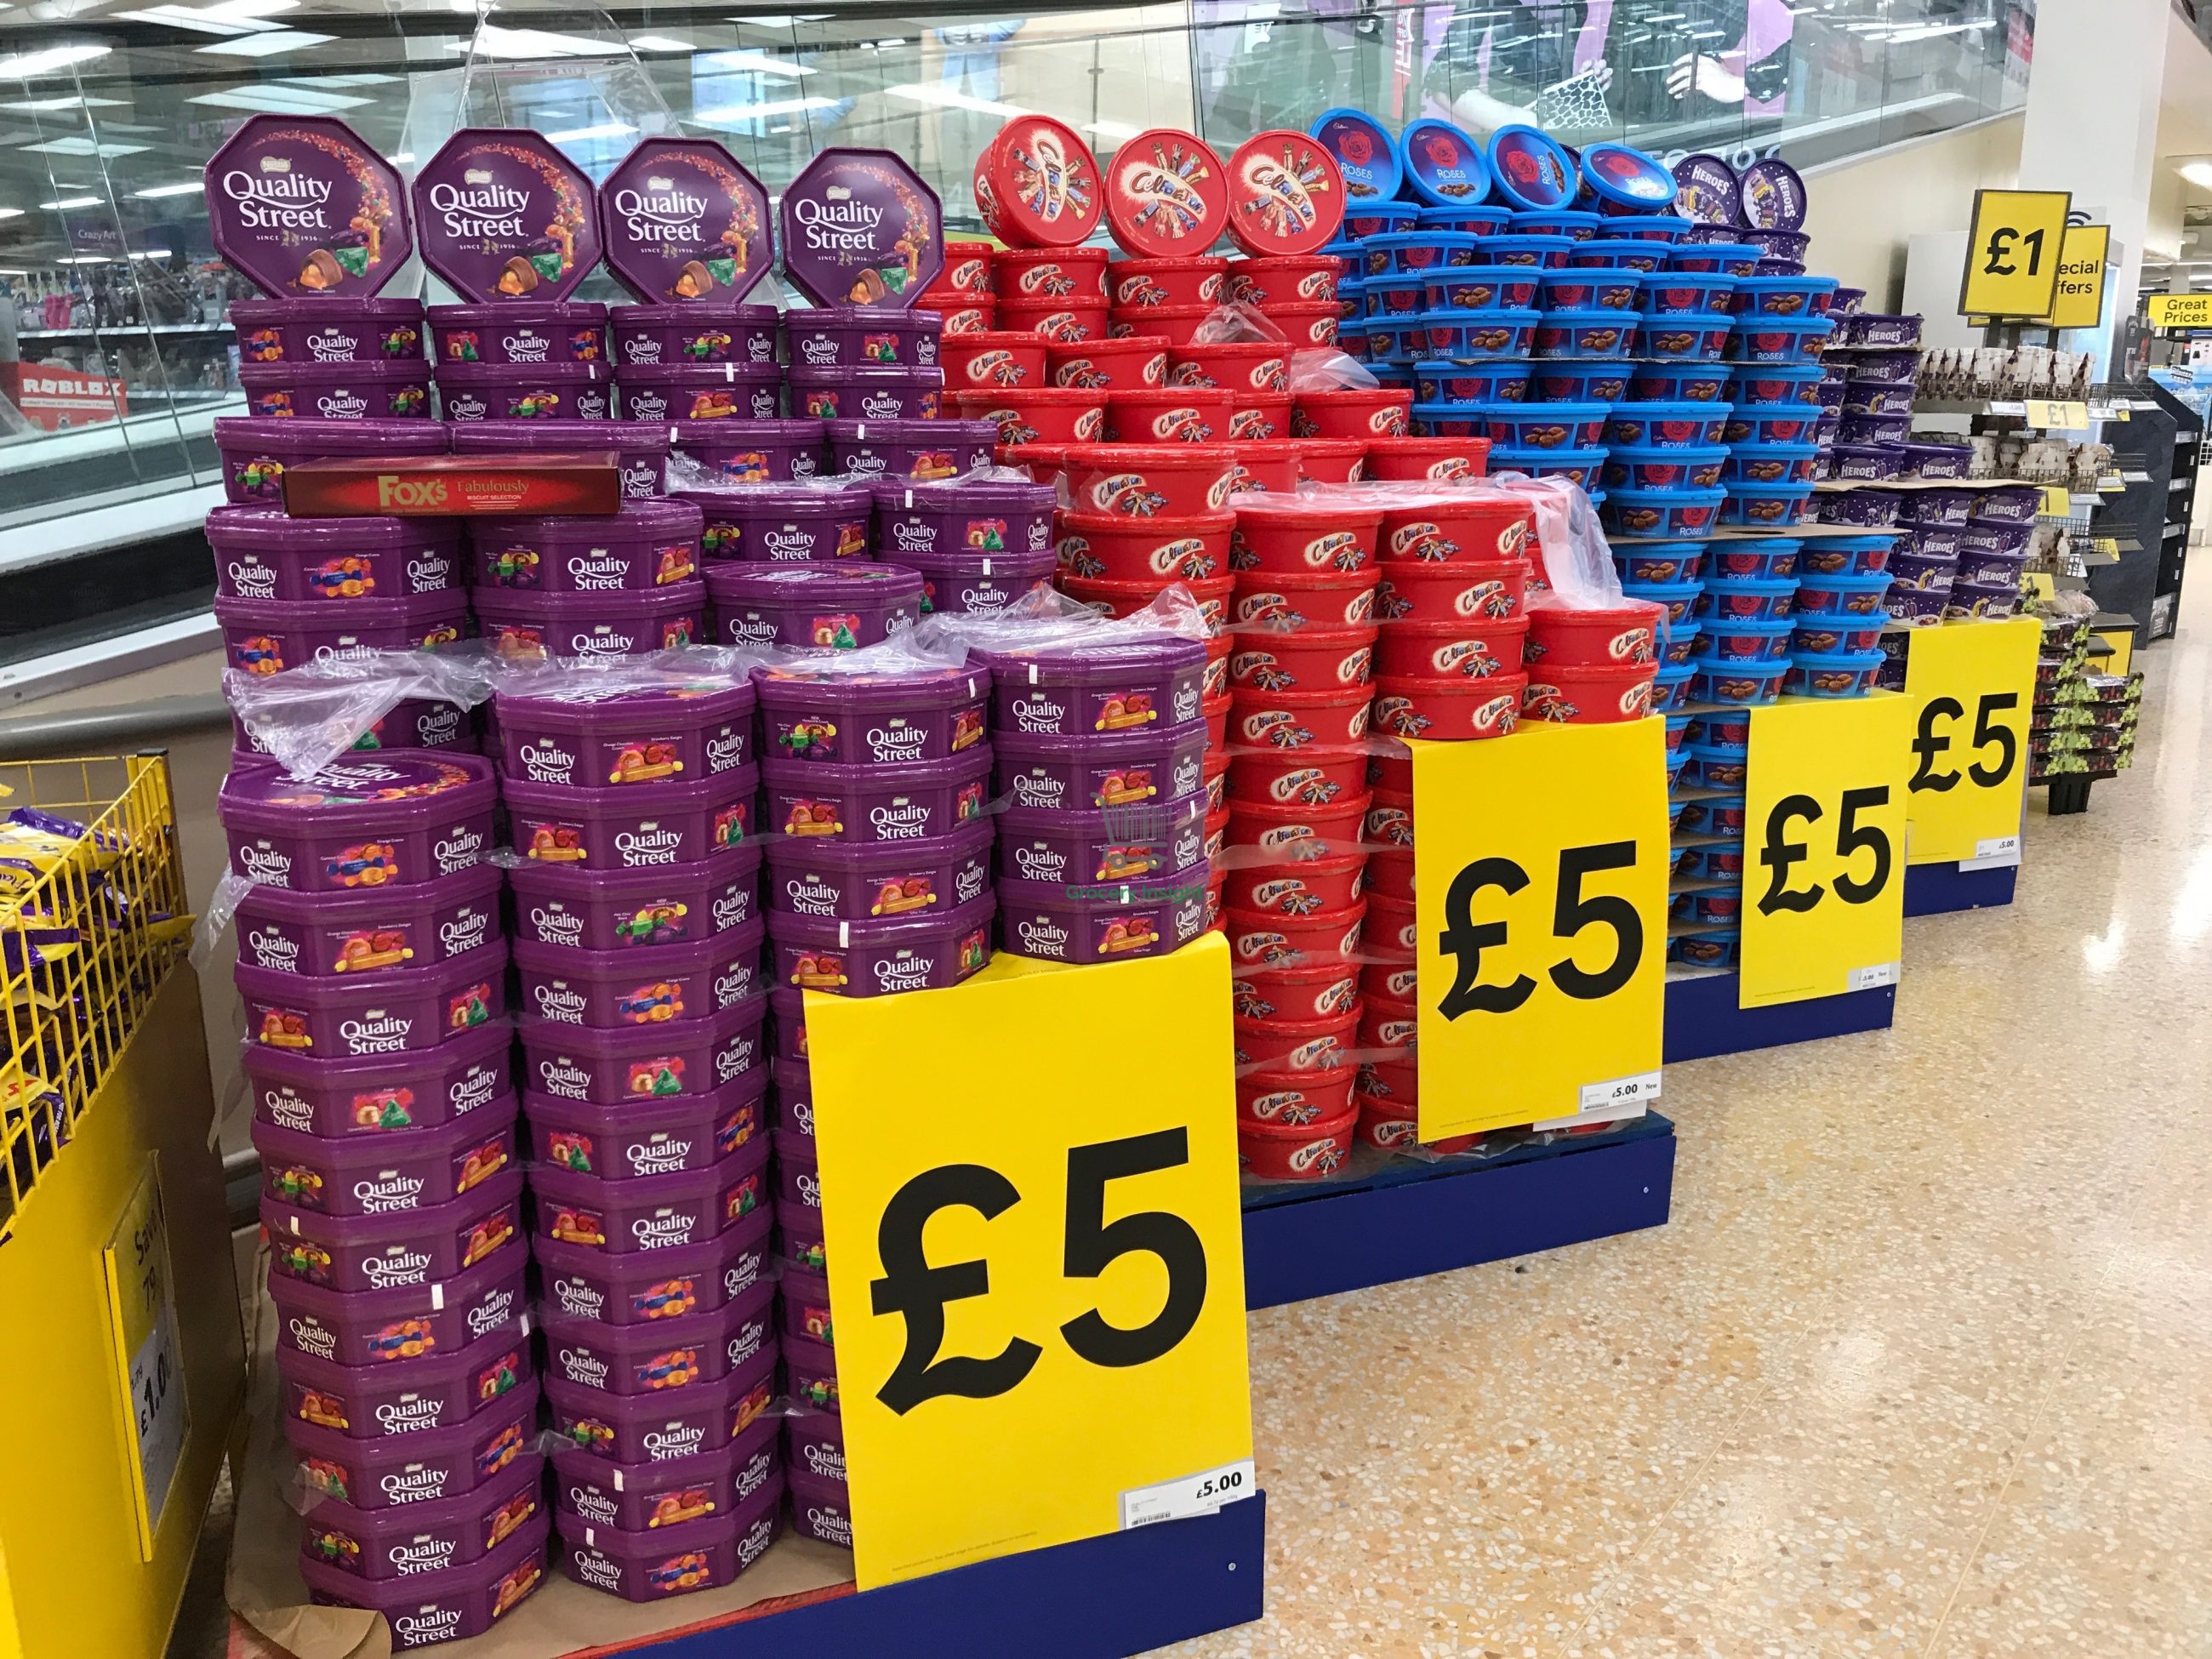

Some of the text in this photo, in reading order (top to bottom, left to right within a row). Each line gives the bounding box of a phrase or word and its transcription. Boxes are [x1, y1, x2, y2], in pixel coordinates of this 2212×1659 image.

[1342, 162, 1372, 180] ROSES
[1437, 168, 1467, 180] ROSES
[1542, 155, 1552, 185] ROSES
[223, 171, 333, 208] Quality
[1691, 165, 1730, 196] HEROES
[430, 184, 530, 219] Quality
[615, 189, 708, 224] Quality
[1776, 176, 1796, 218] HEROES
[242, 205, 327, 229] Street
[795, 198, 883, 232] Quality
[445, 213, 524, 237] Street
[628, 218, 702, 242] Street
[806, 226, 875, 249] Street
[1983, 227, 2045, 276] £1
[2059, 260, 2099, 274] ecial
[2057, 280, 2093, 294] ffers
[2167, 299, 2208, 311] Great
[2164, 312, 2208, 322] Prices
[307, 335, 358, 354] Quality
[1868, 330, 1901, 342] HEROES
[503, 337, 550, 356] Quality
[625, 339, 662, 357] Quality
[801, 339, 840, 357] Quality
[314, 351, 354, 362] Street
[509, 351, 547, 362] Street
[630, 351, 659, 364] Street
[807, 352, 836, 363] Street
[1757, 352, 1783, 361] ROSES
[1856, 367, 1890, 379] HEROES
[23, 379, 122, 396] ROBLOX
[630, 396, 667, 414] Quality
[636, 408, 664, 421] Street
[1884, 400, 1909, 411] HEROES
[2048, 404, 2069, 426] £1
[1874, 430, 1902, 442] HEROES
[1841, 465, 1876, 478] HEROES
[1923, 464, 1956, 476] HEROES
[457, 480, 529, 494] Fabulously
[1985, 504, 2021, 517] HEROES
[764, 531, 816, 553] Quality
[893, 522, 938, 544] Quality
[770, 547, 811, 560] Street
[898, 538, 933, 552] Street
[1924, 541, 1955, 553] HEROES
[228, 562, 277, 589] Quality
[408, 557, 450, 583] Quality
[567, 556, 630, 587] Quality
[1977, 570, 2010, 584] HEROES
[236, 582, 275, 599] Street
[412, 577, 446, 594] Street
[575, 576, 625, 591] Street
[730, 619, 778, 641] Quality
[1012, 699, 1065, 722] Quality
[1018, 718, 1060, 734] Street
[706, 734, 744, 759] Quality
[866, 726, 929, 750] Quality
[1907, 692, 2019, 795] £5
[521, 745, 575, 772] Quality
[874, 744, 923, 762] Street
[710, 755, 740, 774] Street
[528, 766, 573, 784] Street
[614, 831, 682, 854] Quality
[1757, 784, 1892, 917] £5
[1999, 841, 2014, 849] £5.00
[240, 846, 291, 875] Quality
[623, 849, 676, 867] Street
[1016, 849, 1067, 871] Quality
[248, 869, 289, 888] Street
[1022, 865, 1063, 883] Street
[440, 912, 488, 942] Quality
[1018, 923, 1069, 946] Quality
[1437, 840, 1644, 1023] £5
[446, 933, 484, 957] Street
[1024, 940, 1064, 957] Street
[874, 958, 933, 978] Quality
[881, 976, 927, 992] Street
[340, 1018, 412, 1040] Quality
[350, 1037, 407, 1056] Street
[716, 1039, 753, 1069] Quality
[720, 1061, 750, 1084] Street
[1612, 1083, 1638, 1098] £5.00
[627, 1140, 692, 1164] Quality
[634, 1158, 686, 1176] Street
[870, 1126, 1207, 1417] £5
[560, 1349, 609, 1374] Quality
[567, 1369, 605, 1389] Street
[643, 1427, 705, 1450] Quality
[651, 1445, 699, 1462] Street
[380, 1468, 448, 1492] Quality
[1196, 1471, 1242, 1499] £5.00
[390, 1486, 442, 1505] Street
[396, 1609, 462, 1634] Quality
[404, 1627, 456, 1645] Street
